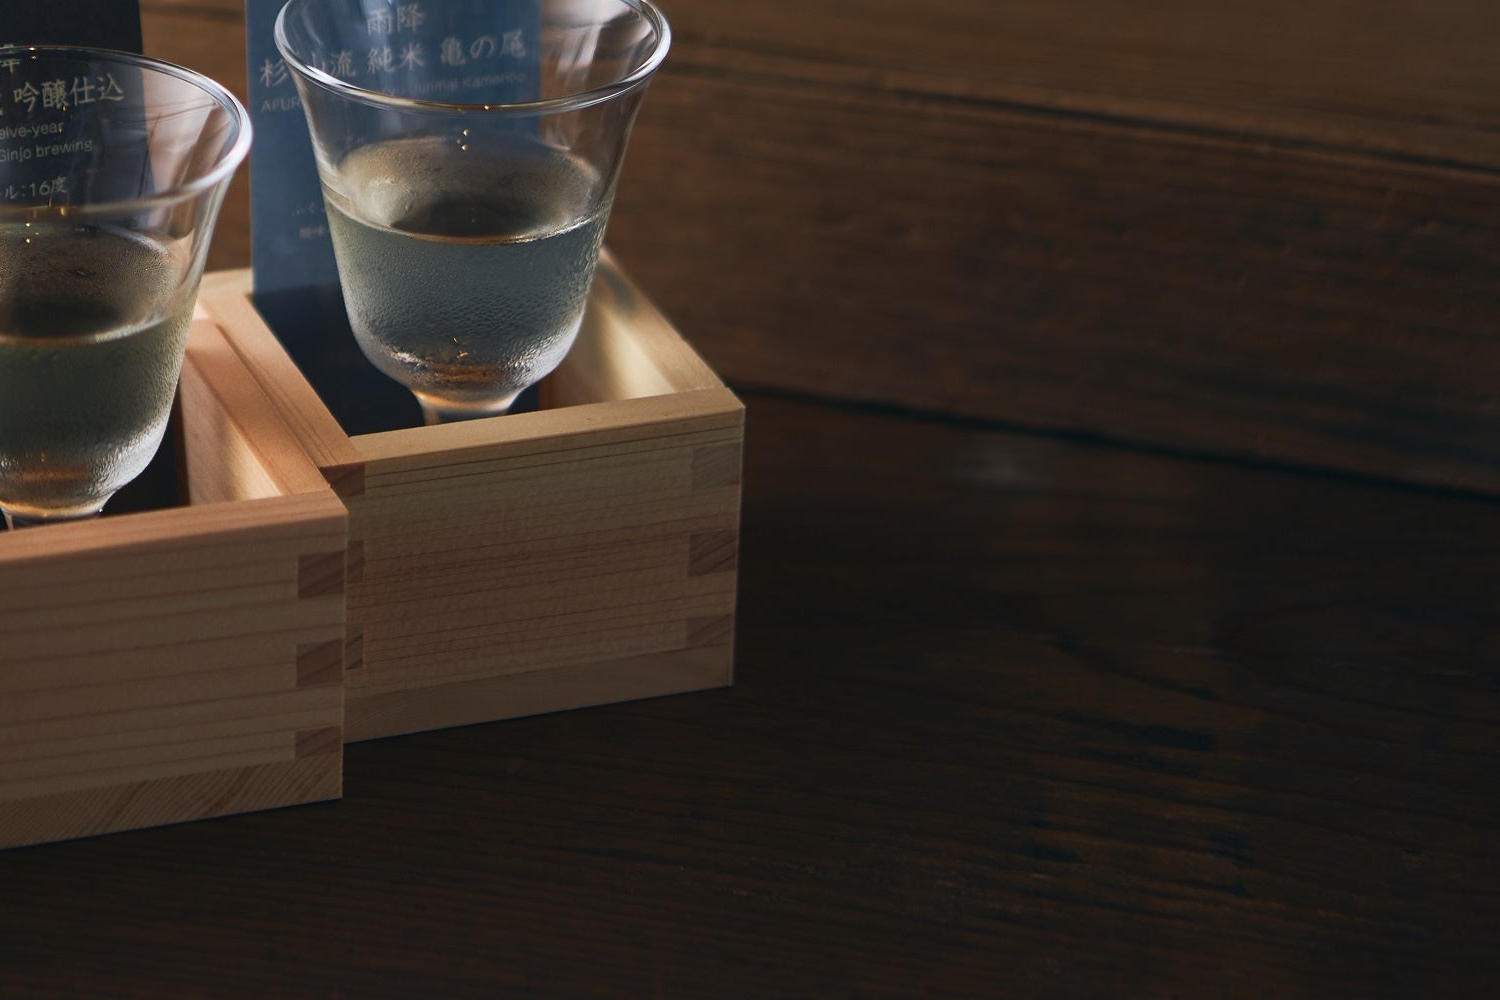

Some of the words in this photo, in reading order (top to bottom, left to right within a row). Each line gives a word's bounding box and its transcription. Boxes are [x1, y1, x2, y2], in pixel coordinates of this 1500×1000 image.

[366, 2, 425, 36] 雨降
[367, 42, 426, 74] 純米
[261, 95, 302, 113] AFUR
[35, 139, 94, 159] brewing
